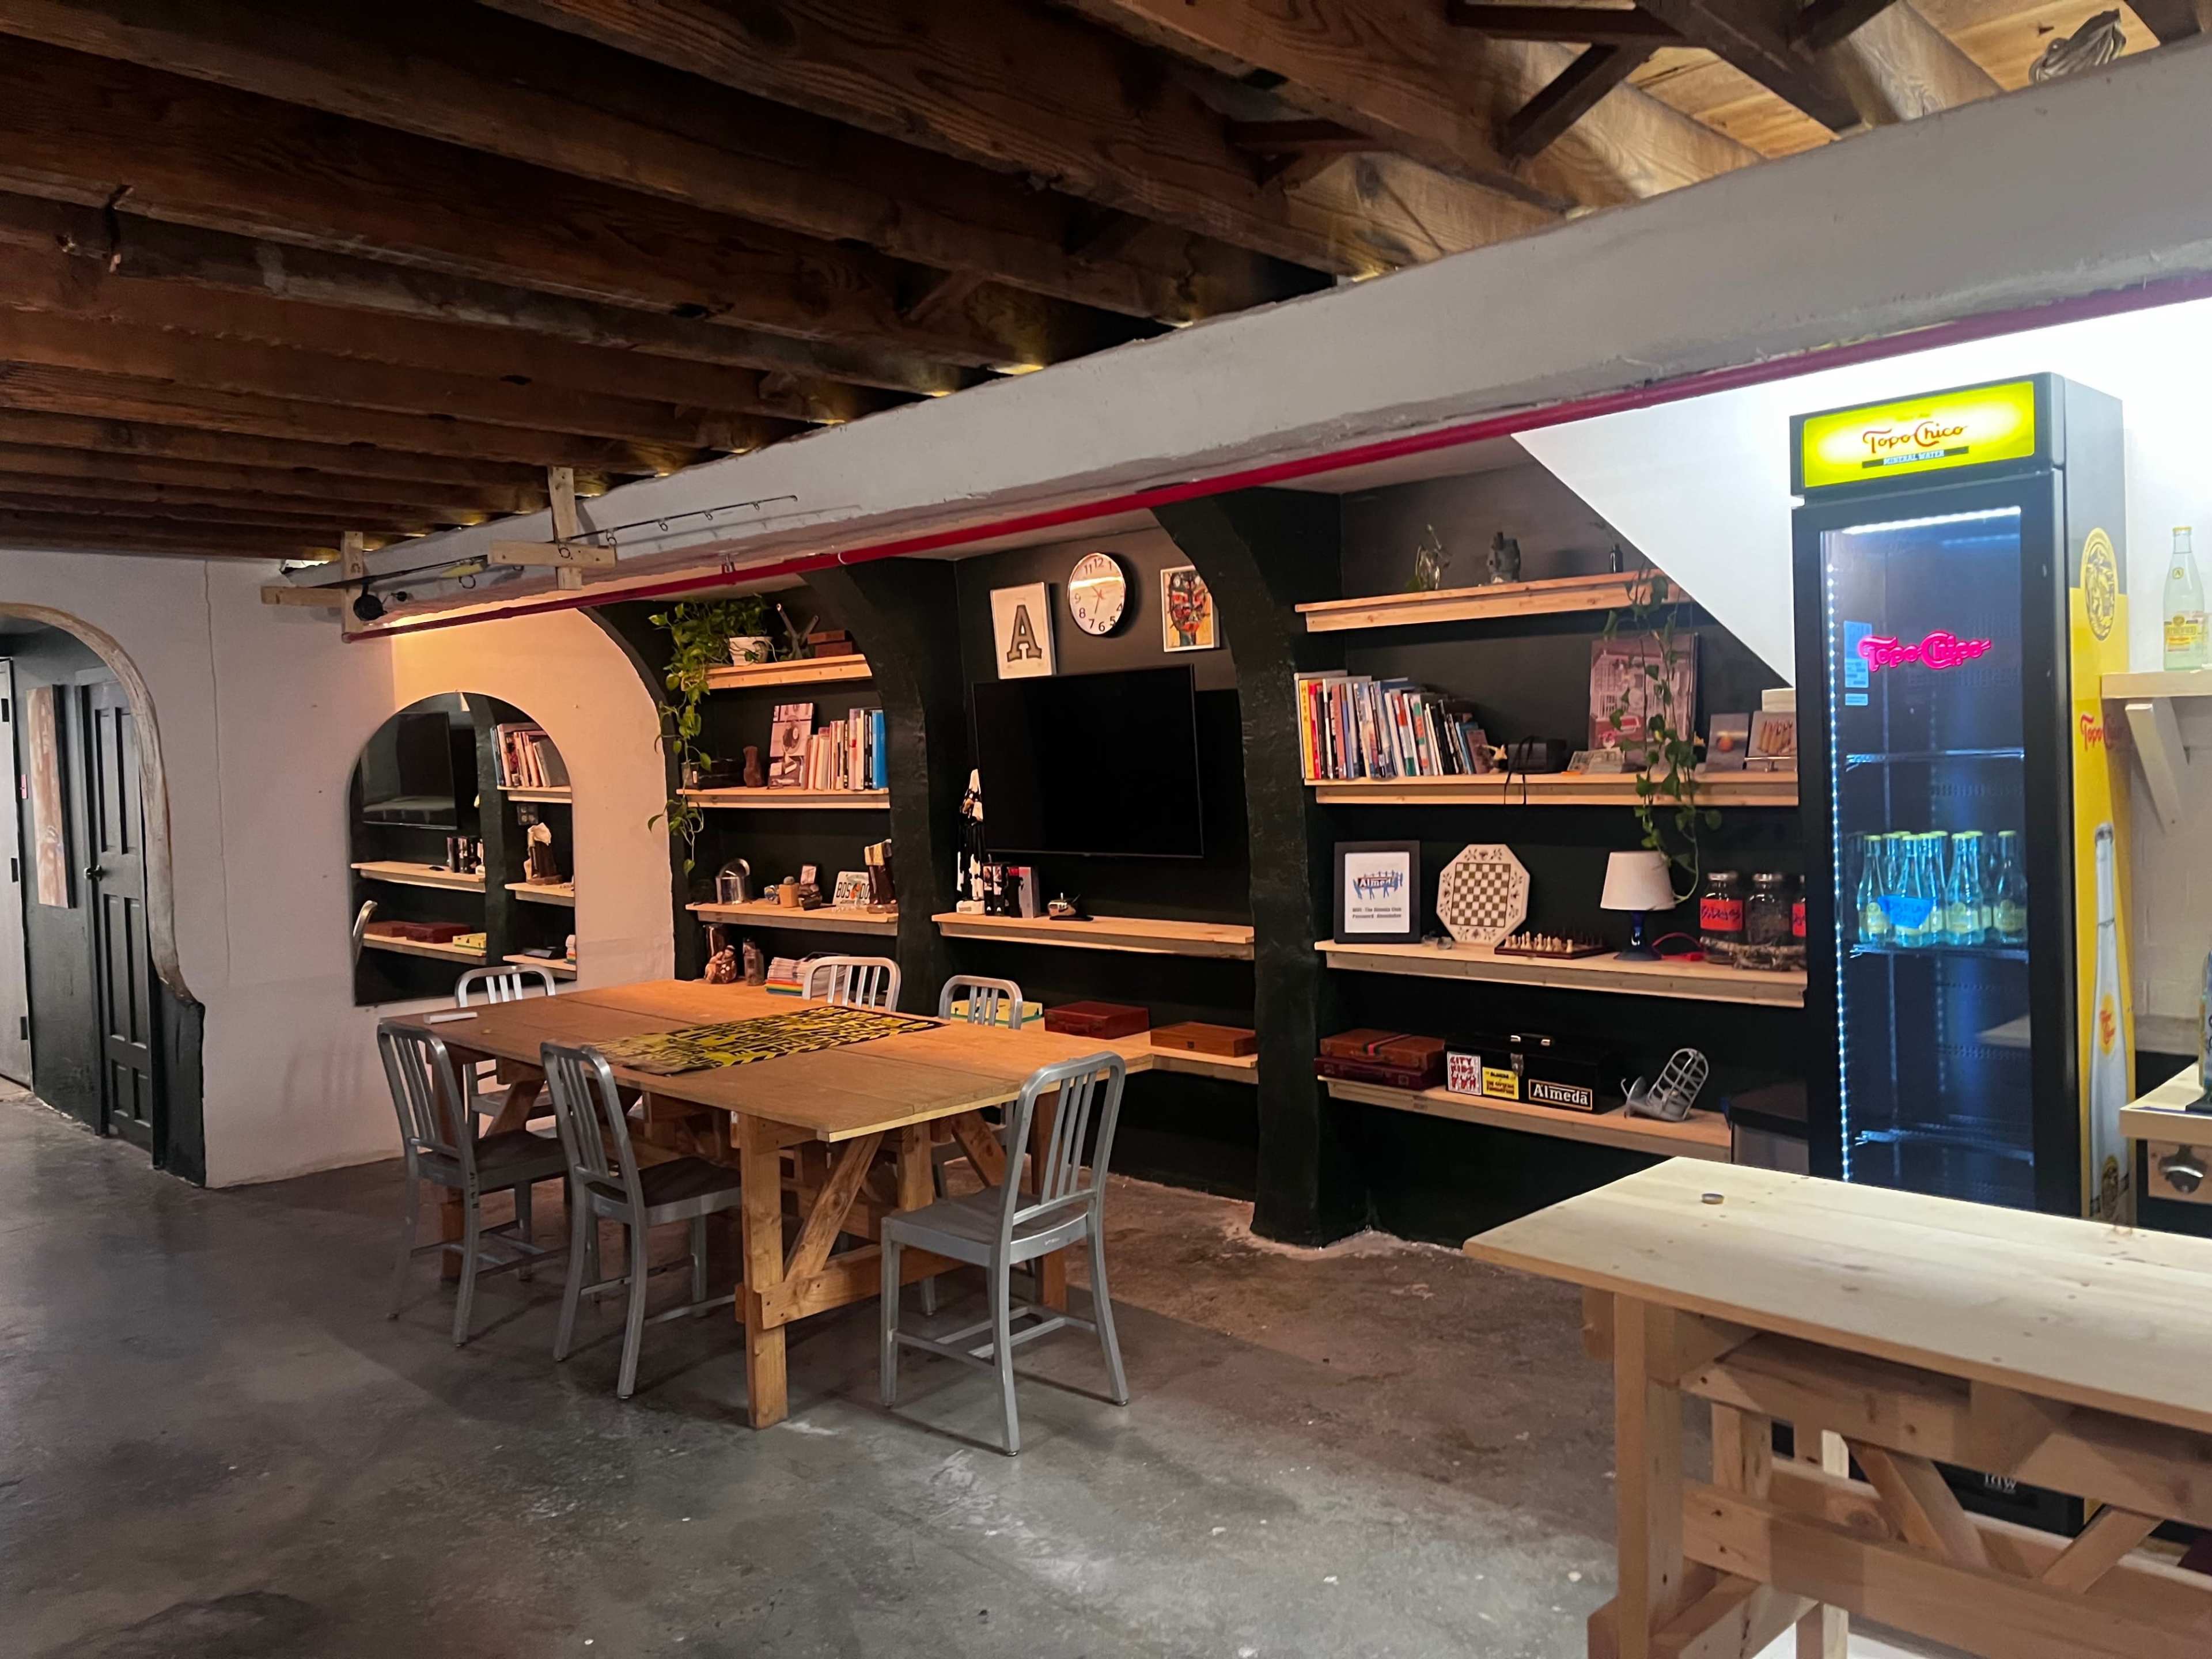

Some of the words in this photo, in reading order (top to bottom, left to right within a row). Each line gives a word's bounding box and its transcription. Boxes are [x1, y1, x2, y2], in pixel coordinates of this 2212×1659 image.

[1863, 429, 1911, 453] Topo
[1914, 421, 1968, 447] Chico
[1883, 454, 1919, 465] MINERAL
[1919, 449, 1945, 460] WATER
[1094, 557, 1104, 569] 12
[1108, 560, 1112, 571] 1
[1084, 564, 1092, 575] 11
[1074, 593, 1081, 604] 9
[1079, 607, 1086, 618] 8
[1116, 603, 1123, 612] 4
[1088, 619, 1095, 629] 7
[1099, 622, 1105, 632] 6
[1109, 616, 1116, 627] 5
[1006, 604, 1042, 662] A
[1858, 635, 1921, 672] Topo
[1921, 631, 1991, 671] Chico
[2080, 714, 2102, 752] Topo
